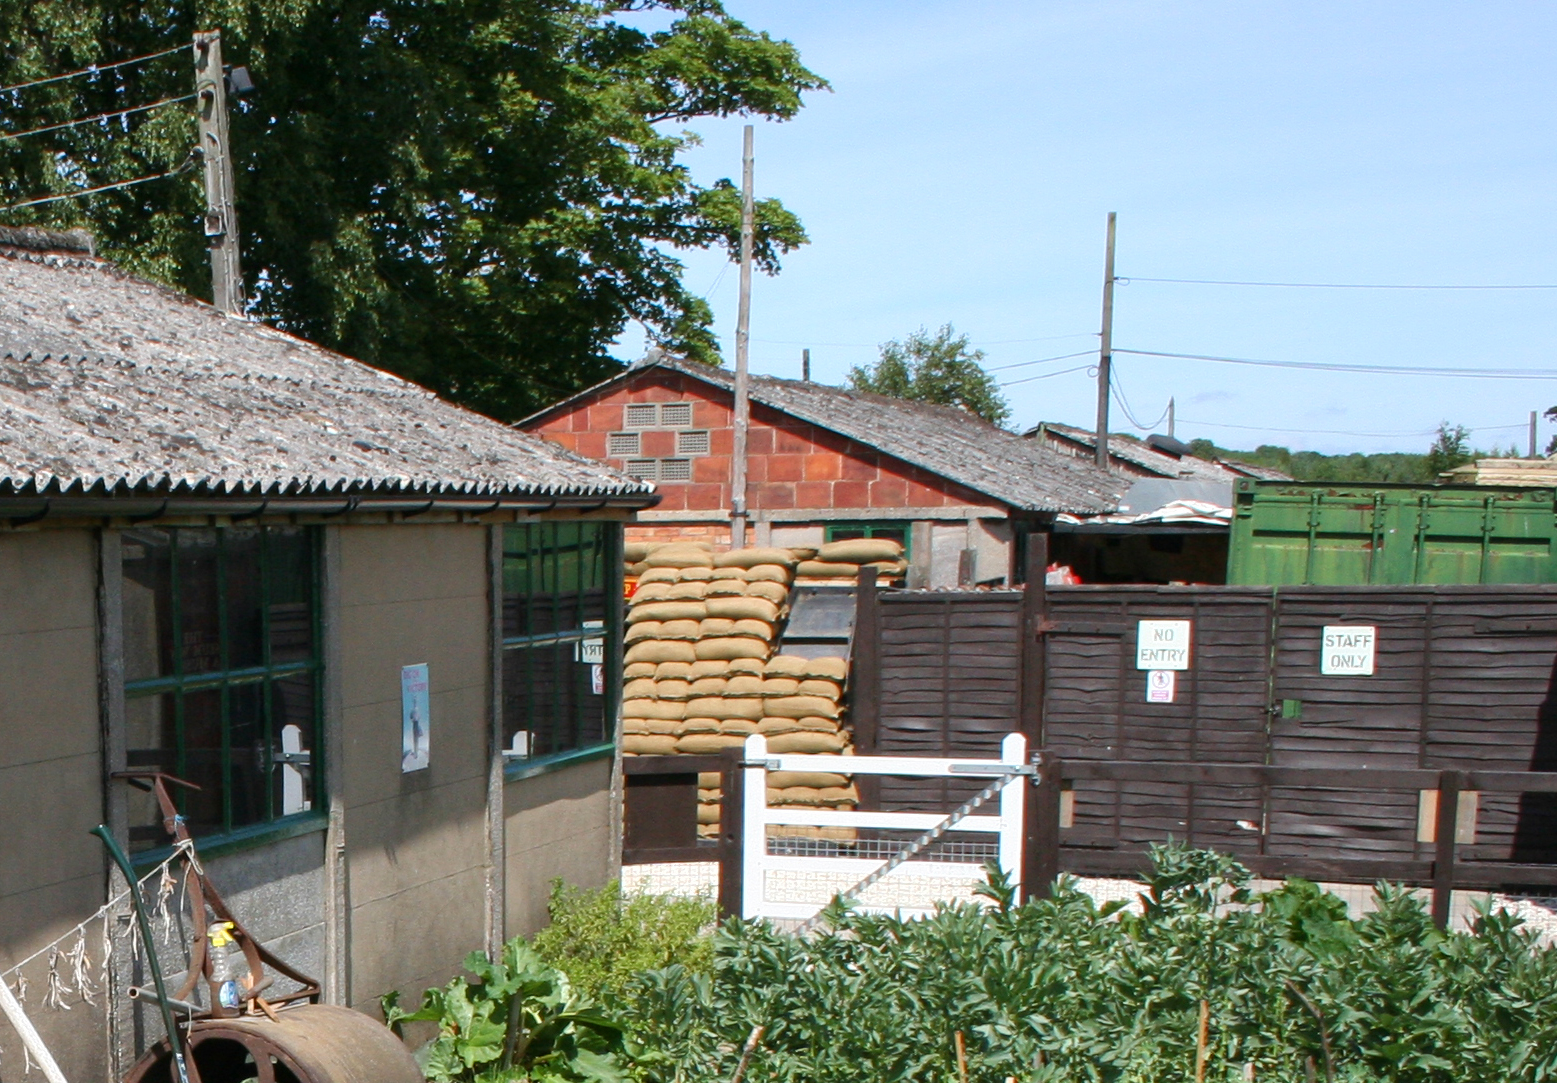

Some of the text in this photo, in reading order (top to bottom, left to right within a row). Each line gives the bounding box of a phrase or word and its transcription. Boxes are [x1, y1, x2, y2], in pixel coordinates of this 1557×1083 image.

[1153, 628, 1175, 642] NO
[1325, 634, 1373, 648] STAFF
[1140, 648, 1186, 662] ENTRY
[1330, 654, 1368, 668] ONLY
